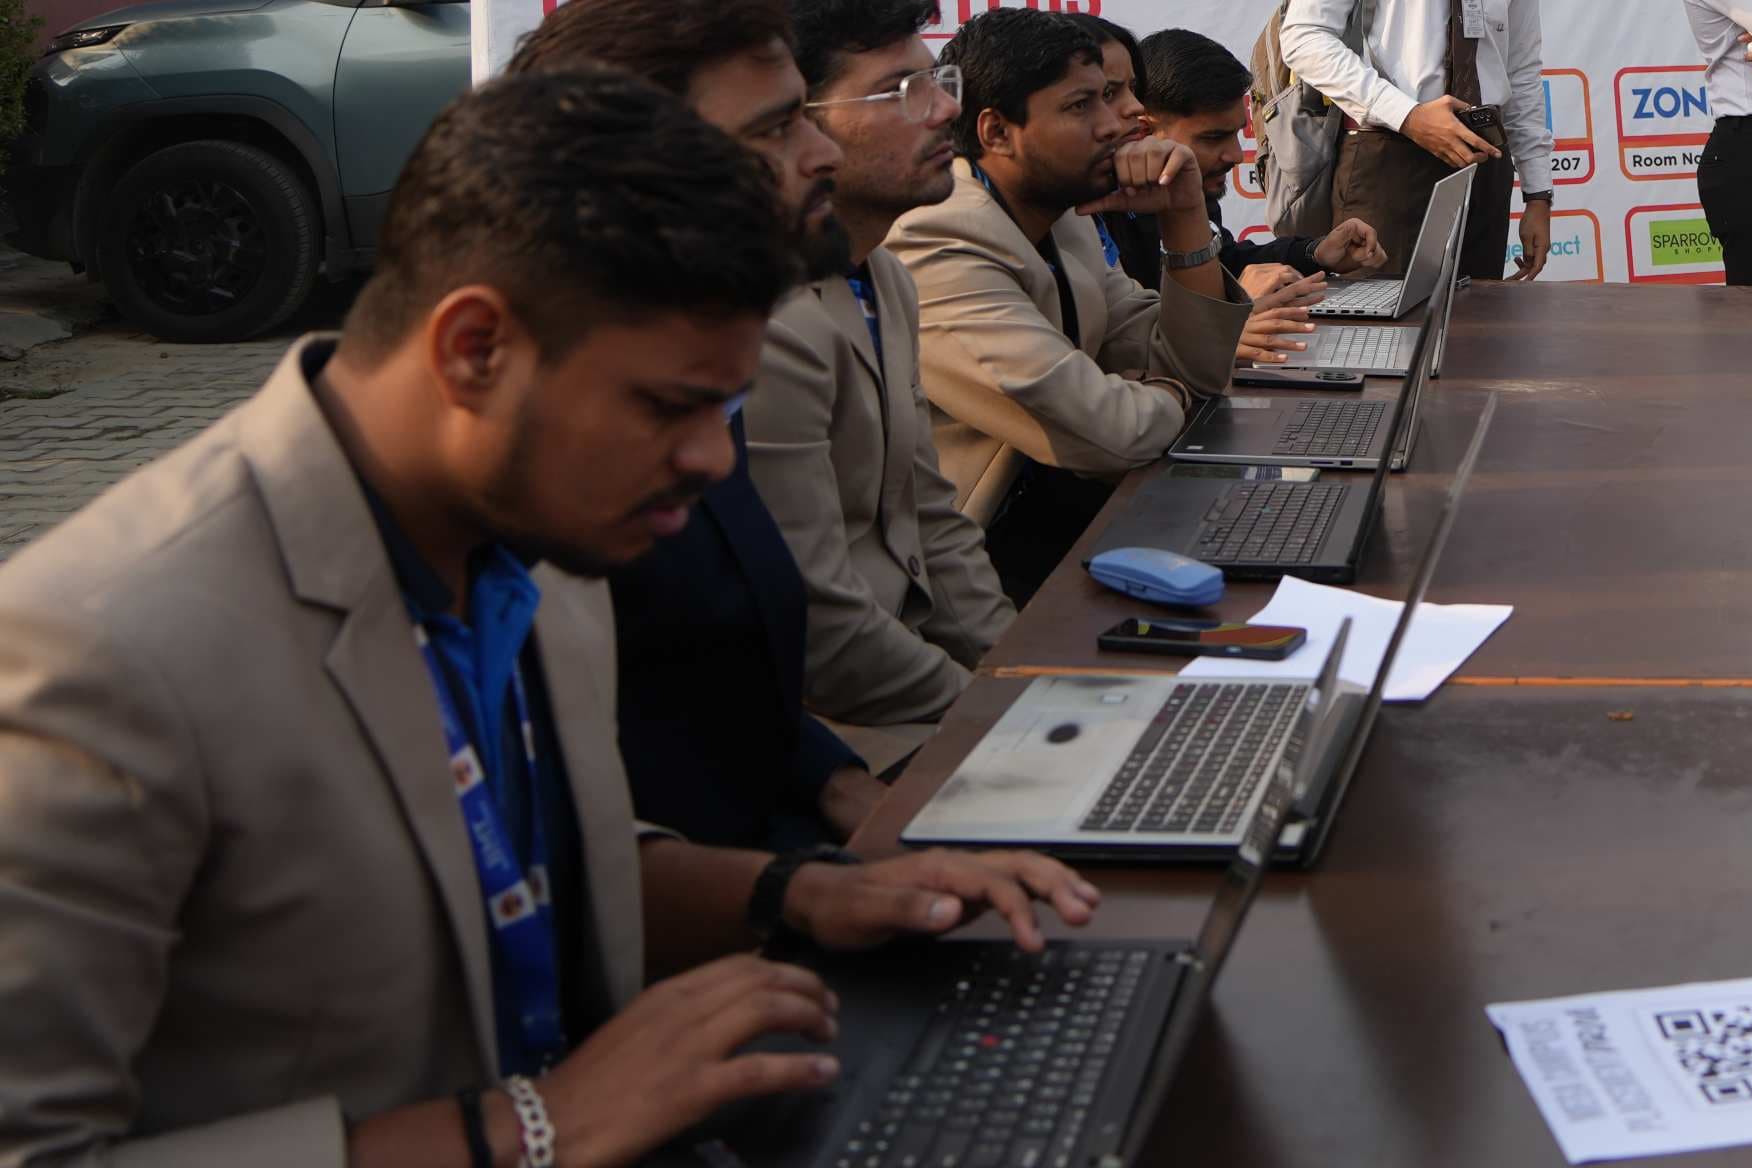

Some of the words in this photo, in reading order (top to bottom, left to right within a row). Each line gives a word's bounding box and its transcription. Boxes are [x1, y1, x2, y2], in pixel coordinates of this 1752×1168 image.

[1632, 86, 1713, 119] ZON
[1551, 157, 1581, 171] 207
[1632, 155, 1678, 168] Room
